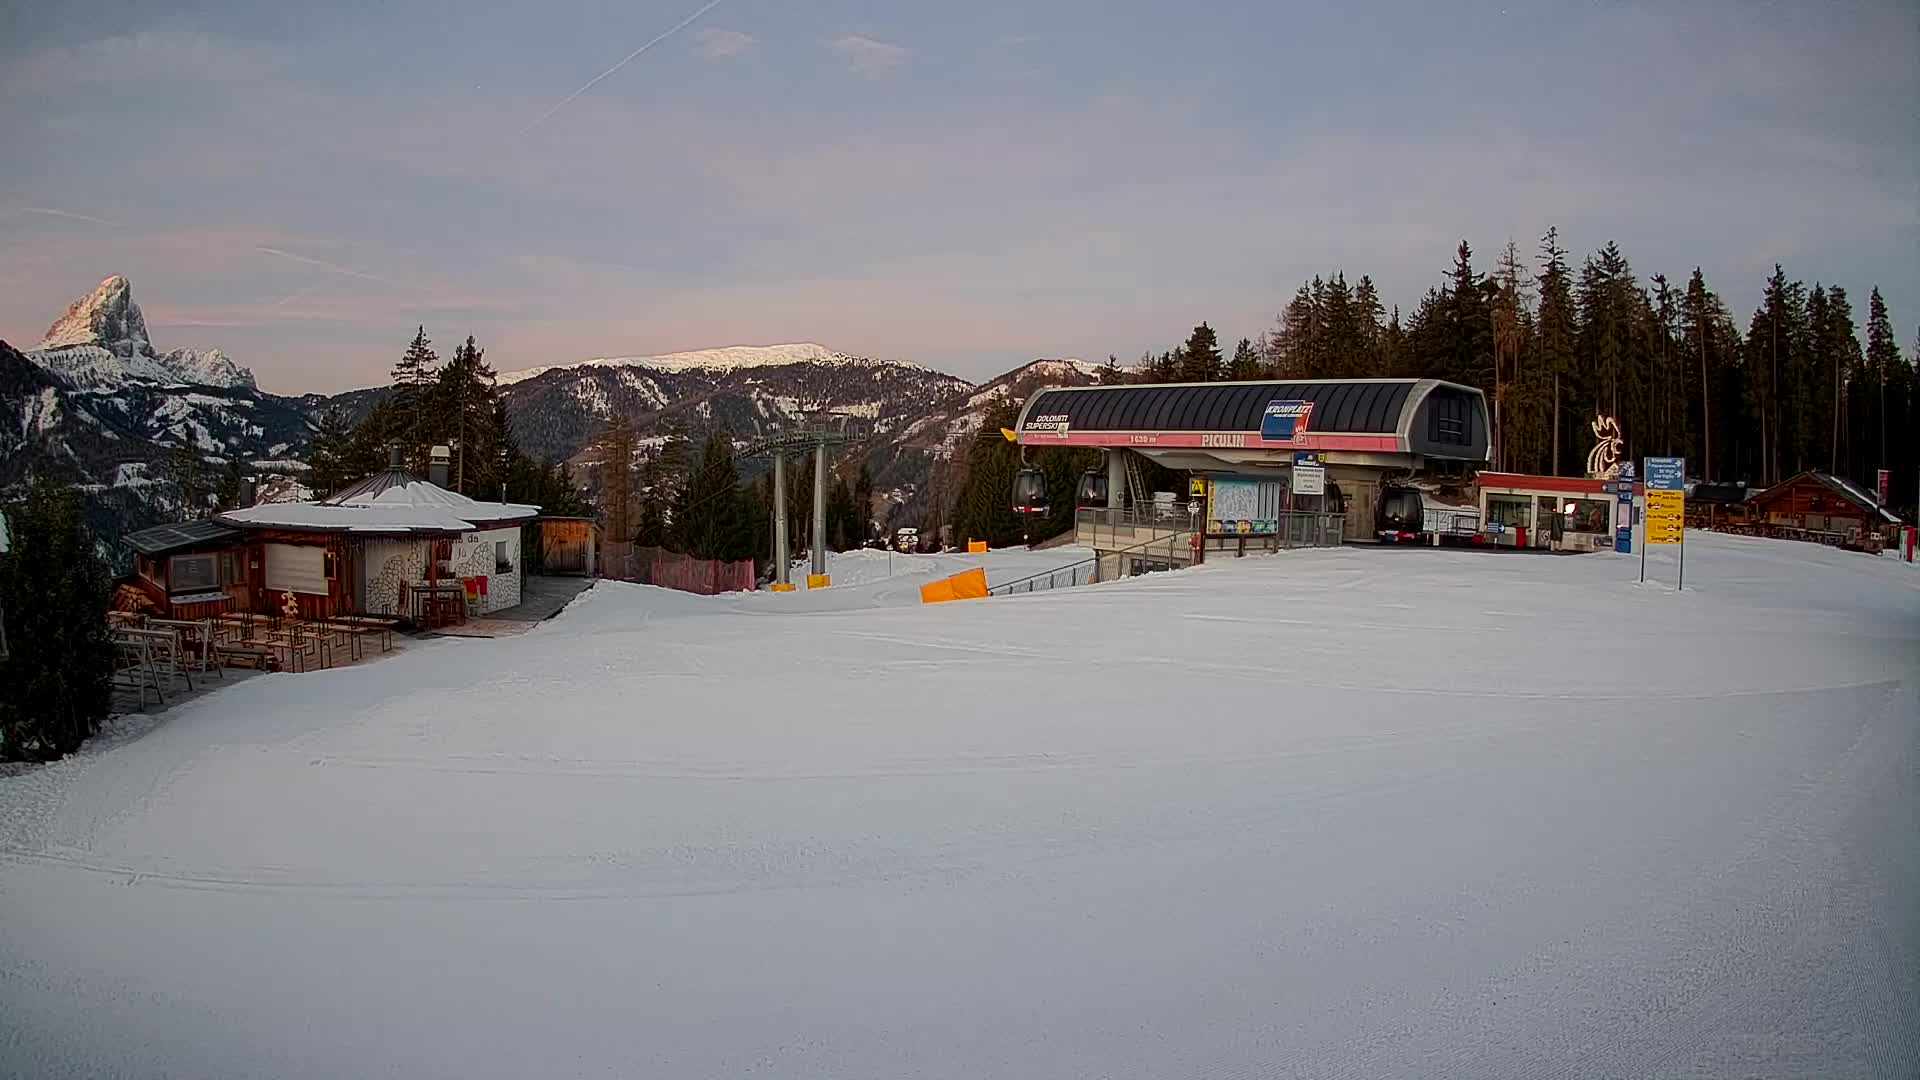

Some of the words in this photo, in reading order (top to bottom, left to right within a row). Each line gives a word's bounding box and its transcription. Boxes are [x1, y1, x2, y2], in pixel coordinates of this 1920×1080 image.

[1026, 422, 1059, 430] SUPERSKI
[1201, 434, 1245, 448] PICULIN
[467, 534, 479, 543] da
